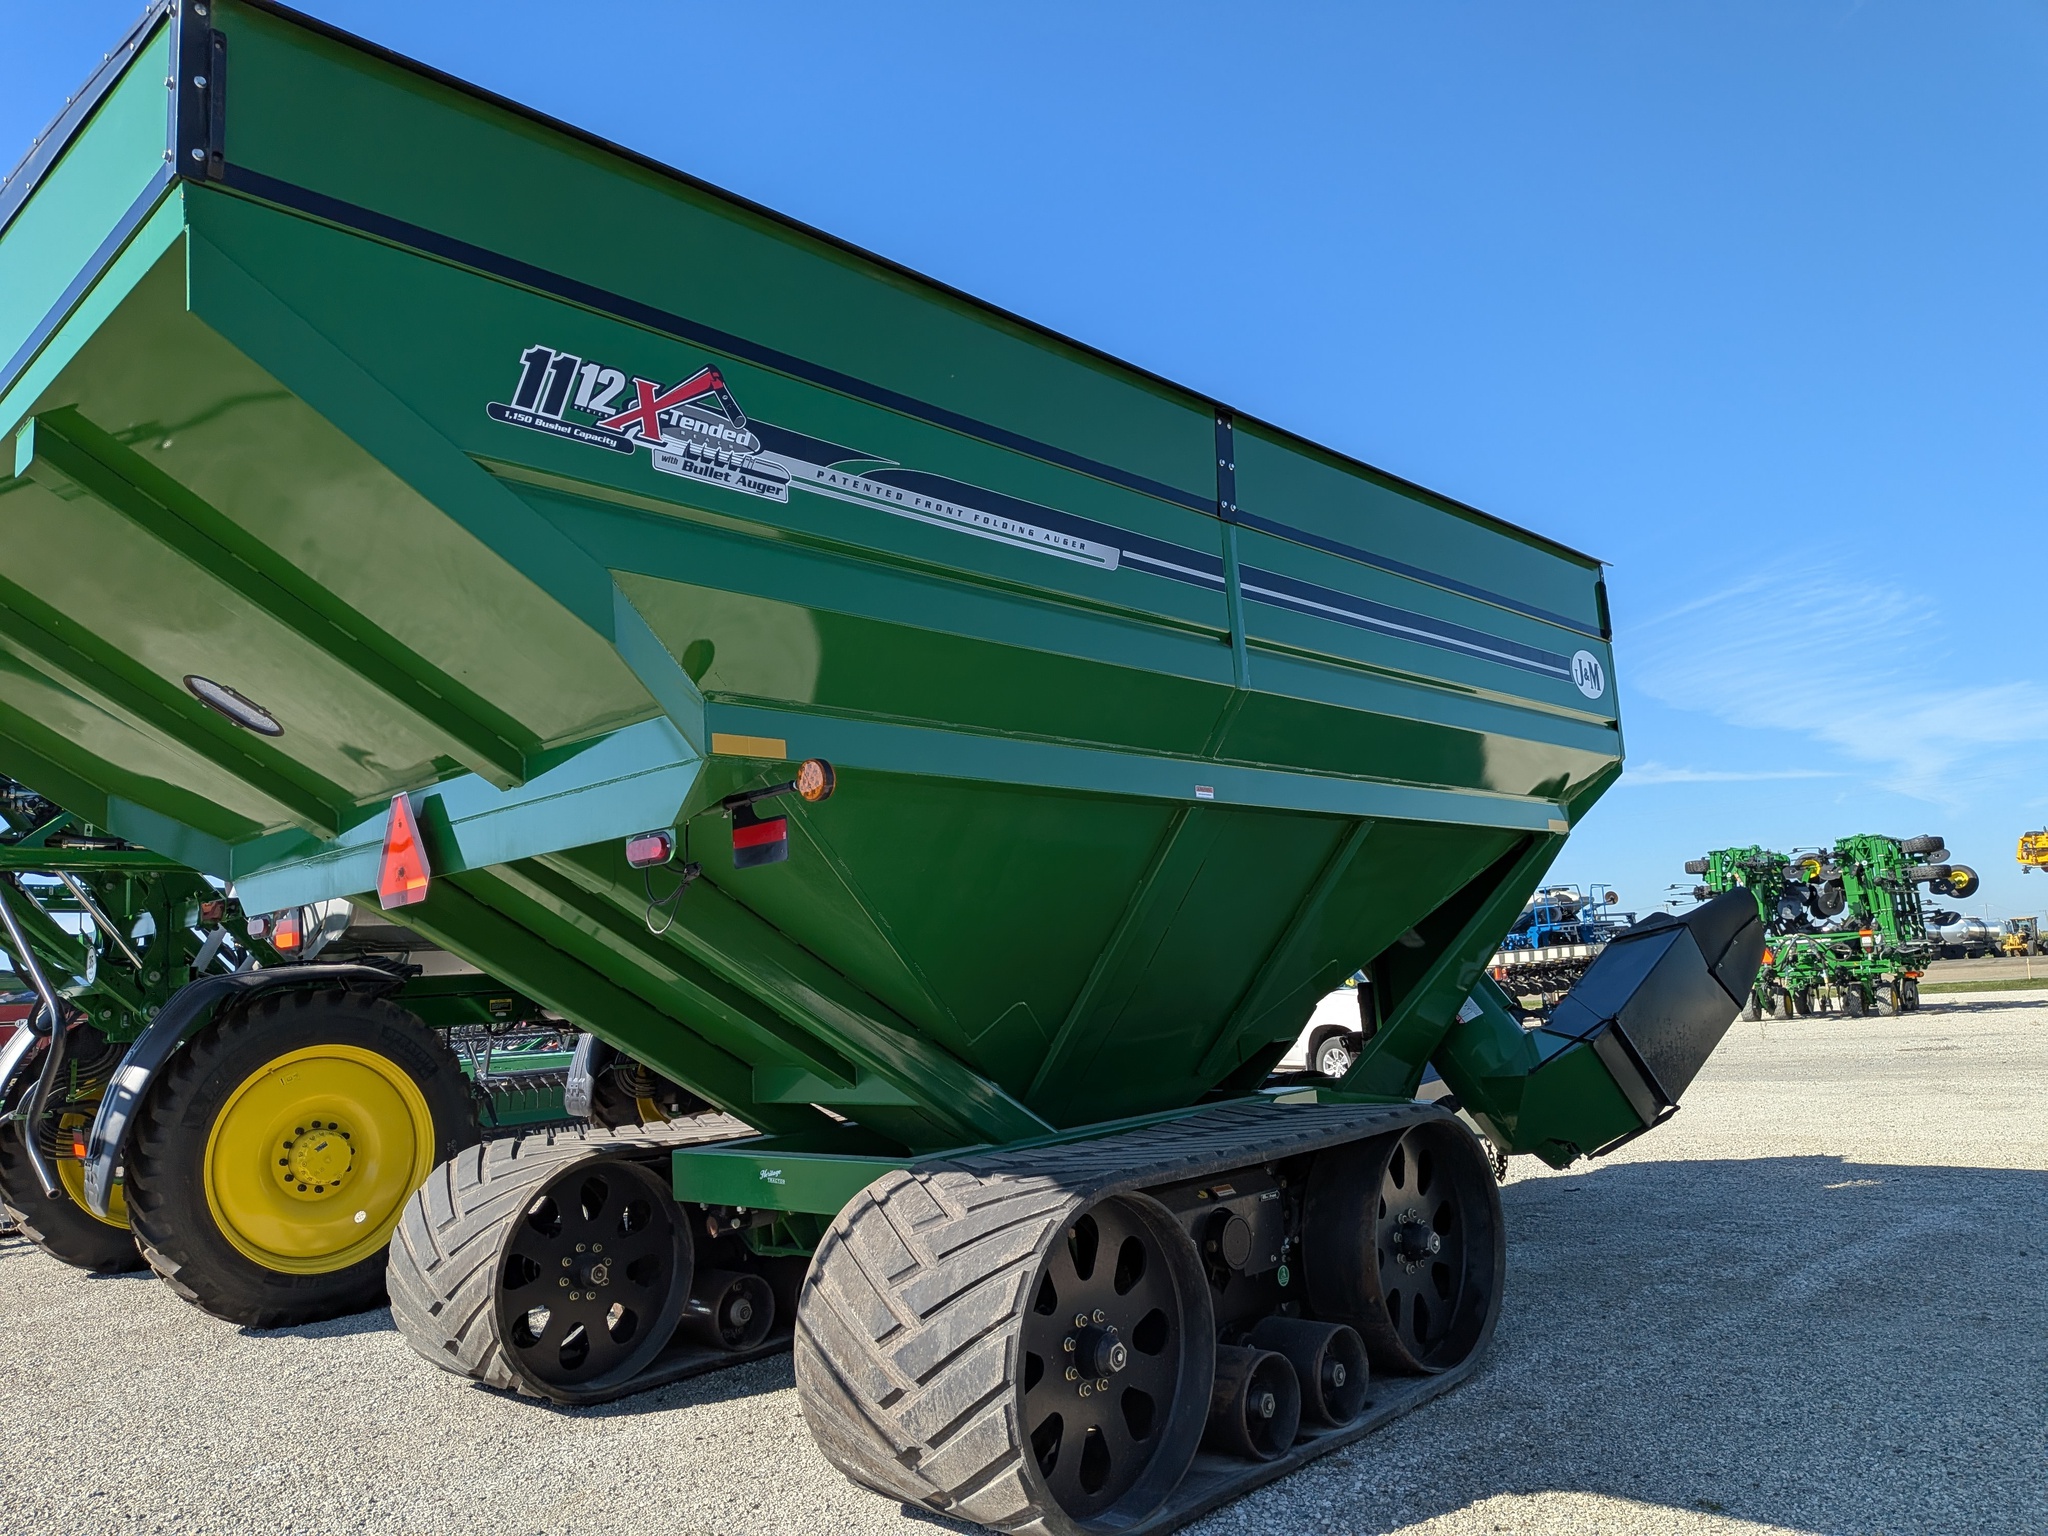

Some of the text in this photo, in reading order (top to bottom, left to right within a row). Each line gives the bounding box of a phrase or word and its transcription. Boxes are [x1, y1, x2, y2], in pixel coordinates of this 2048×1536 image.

[504, 410, 617, 447] 1,150 Bushel Capacity
[661, 454, 784, 496] with Bullet Auger
[816, 470, 1087, 551] PATENTED FRONT FOLDING AUGER
[1574, 658, 1602, 692] J&M
